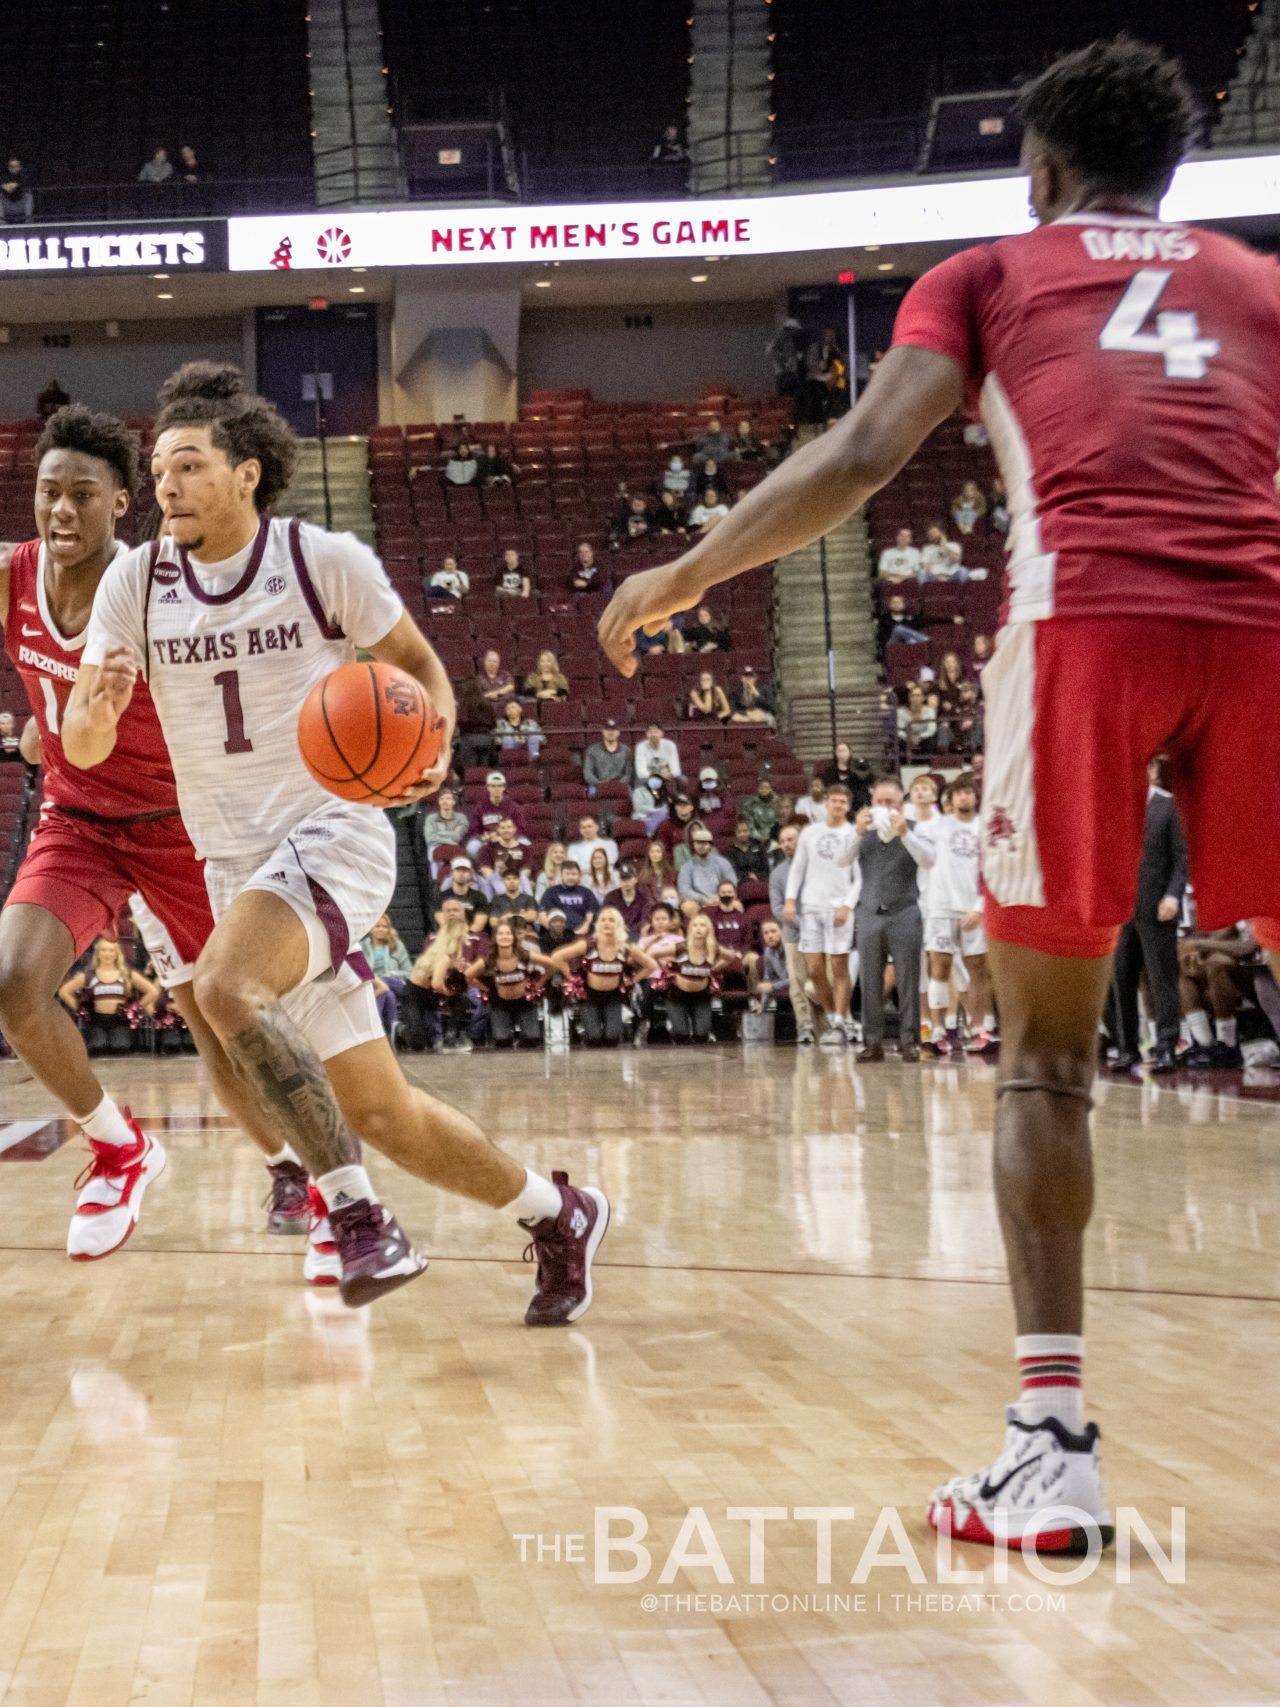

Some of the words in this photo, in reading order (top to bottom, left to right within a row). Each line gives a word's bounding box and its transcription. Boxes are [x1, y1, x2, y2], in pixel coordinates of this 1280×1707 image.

[431, 226, 517, 252] NEXT
[530, 222, 640, 249] MEN'S
[652, 218, 751, 245] GAME
[1080, 228, 1200, 261] DAVIS
[1098, 267, 1221, 380] 4
[19, 644, 81, 683] RAZORB
[152, 631, 238, 665] TEXAS
[247, 621, 303, 656] A&M
[39, 676, 60, 736] 1
[213, 670, 254, 755] 1
